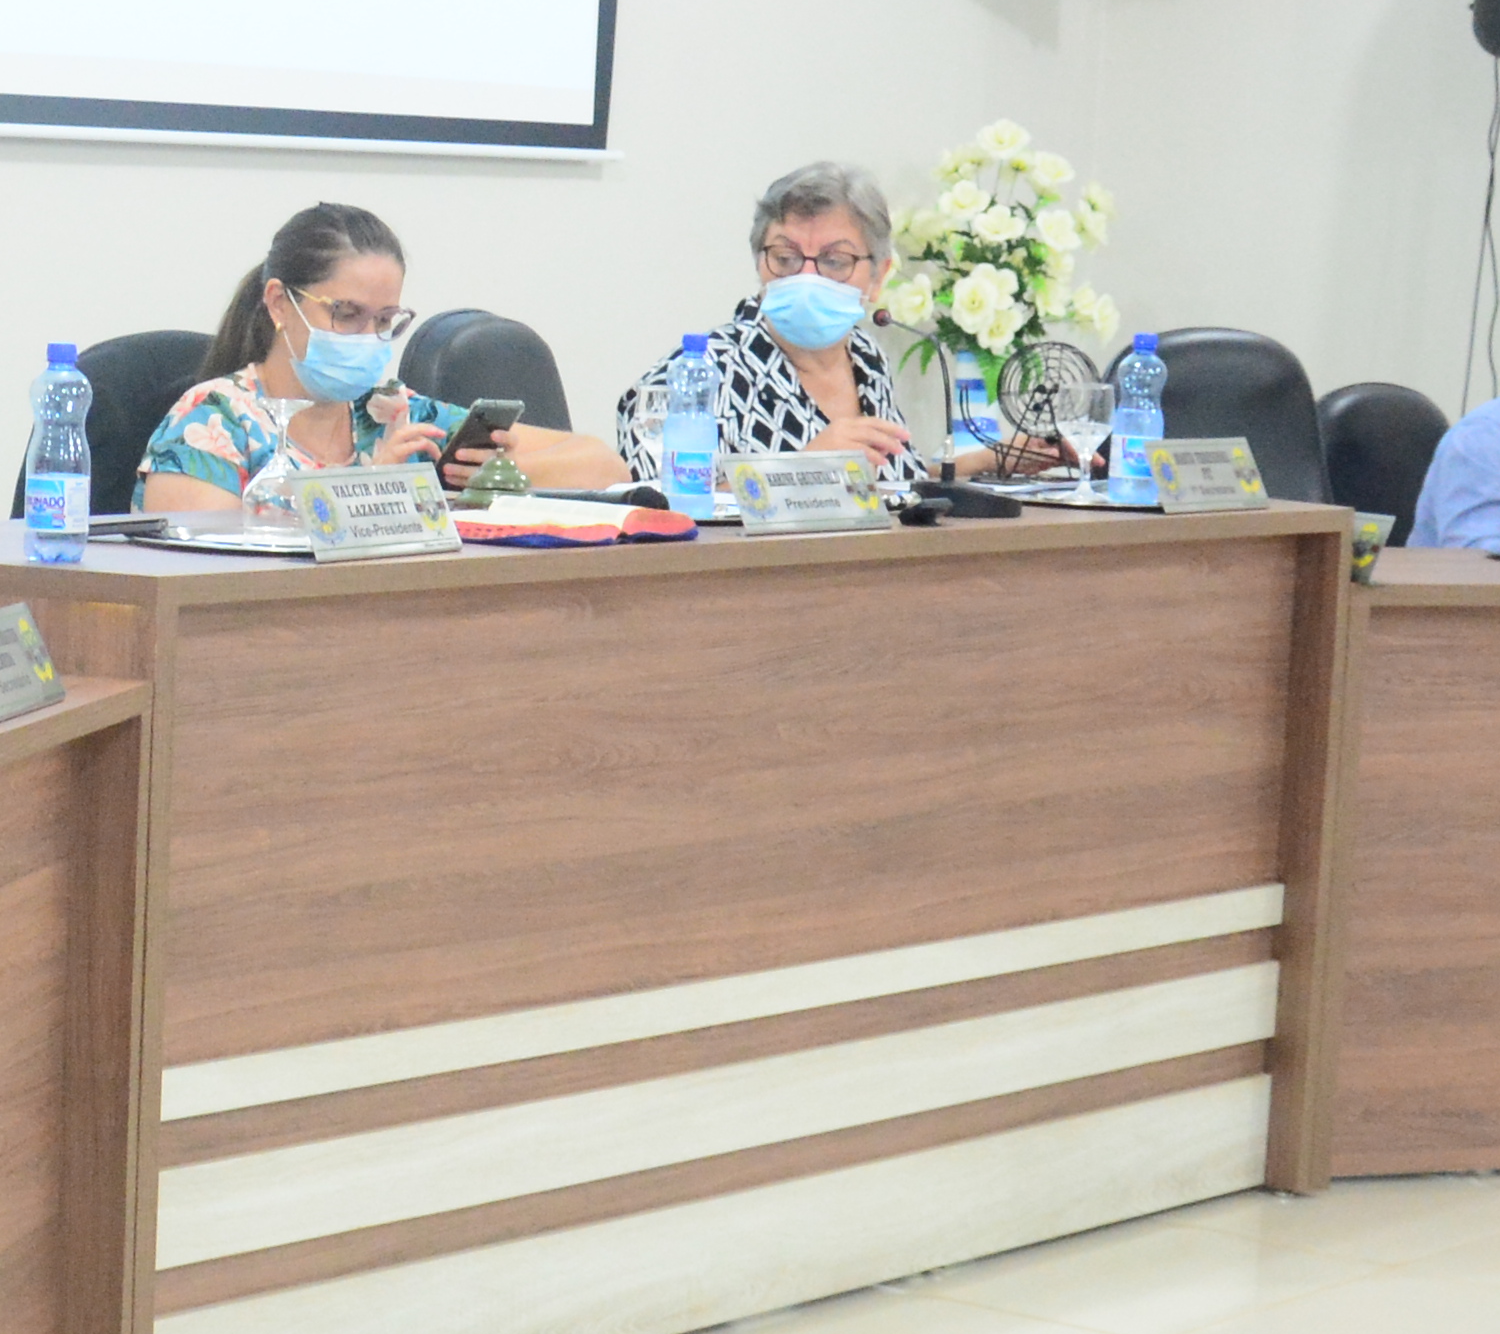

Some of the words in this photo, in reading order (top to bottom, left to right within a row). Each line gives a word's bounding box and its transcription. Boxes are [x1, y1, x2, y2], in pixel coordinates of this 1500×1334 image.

[331, 483, 372, 499] VALCIR
[374, 480, 407, 496] JACOB
[347, 501, 407, 518] LAZARETTI
[784, 496, 841, 510] Presidente
[349, 522, 423, 538] Vice-Presidente
